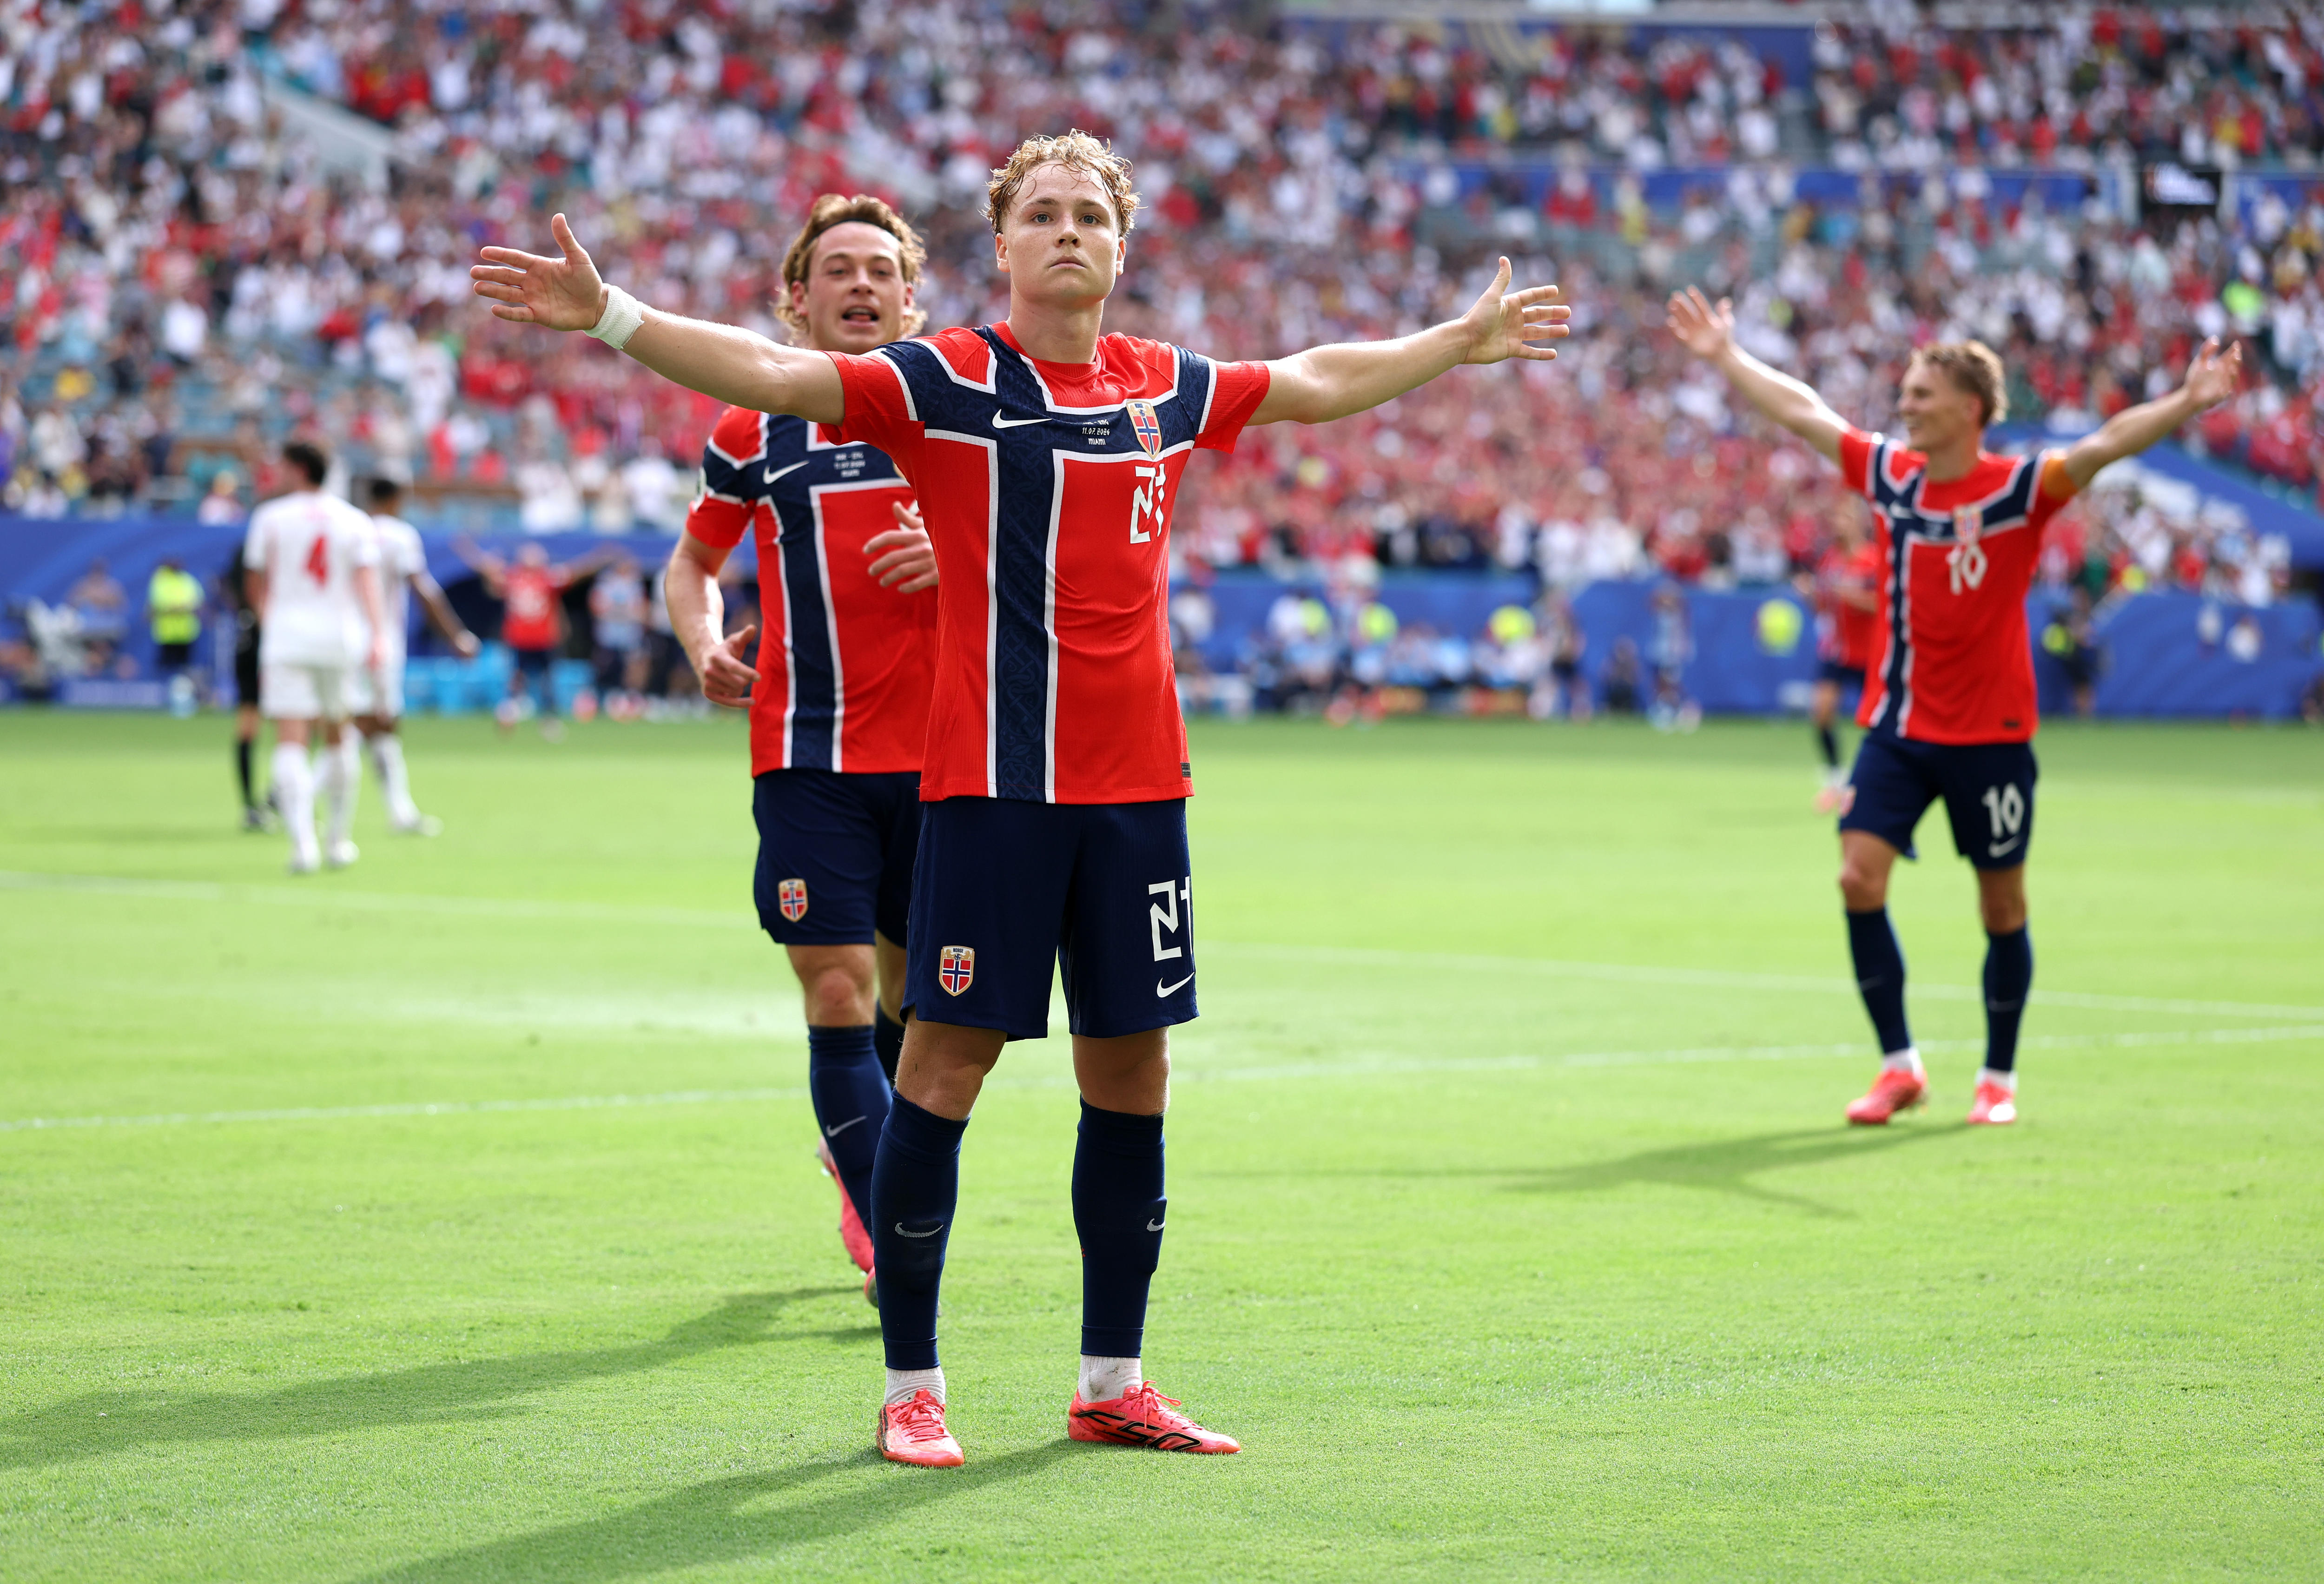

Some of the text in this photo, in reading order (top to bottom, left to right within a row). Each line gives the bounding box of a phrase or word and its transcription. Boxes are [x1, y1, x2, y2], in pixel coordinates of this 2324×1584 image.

[1082, 427, 1110, 436] 11.07.2026
[1130, 463, 1167, 544] 21
[304, 535, 329, 587] 4
[1946, 544, 1988, 595] 10
[1981, 782, 2025, 838] 10
[1148, 876, 1193, 962] 21
